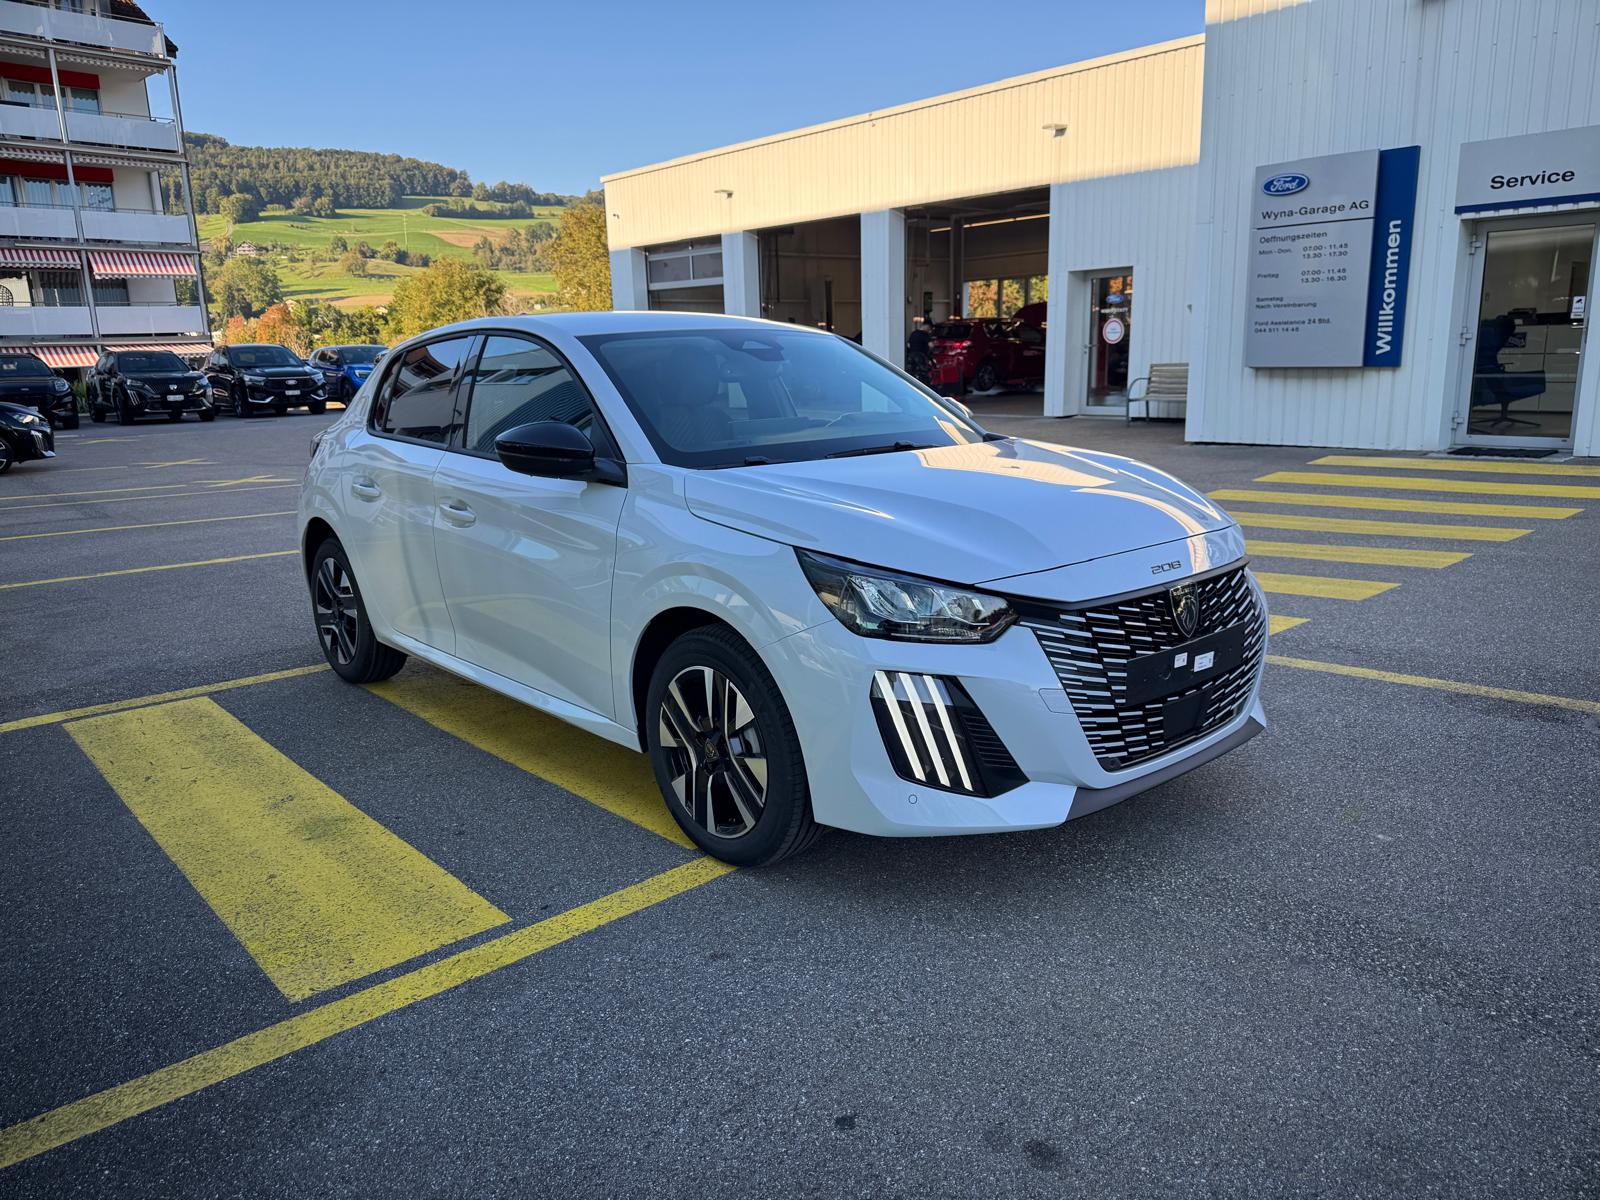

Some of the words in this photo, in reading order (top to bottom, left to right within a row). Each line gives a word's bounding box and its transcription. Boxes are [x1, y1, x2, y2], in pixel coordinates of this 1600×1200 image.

[1270, 177, 1299, 191] Ford
[1490, 170, 1575, 190] Service
[1261, 203, 1345, 221] Wyna-Garage
[1349, 200, 1369, 210] AG
[1259, 231, 1328, 244] Oeffnungszeiten
[1375, 220, 1402, 355] Willkommen
